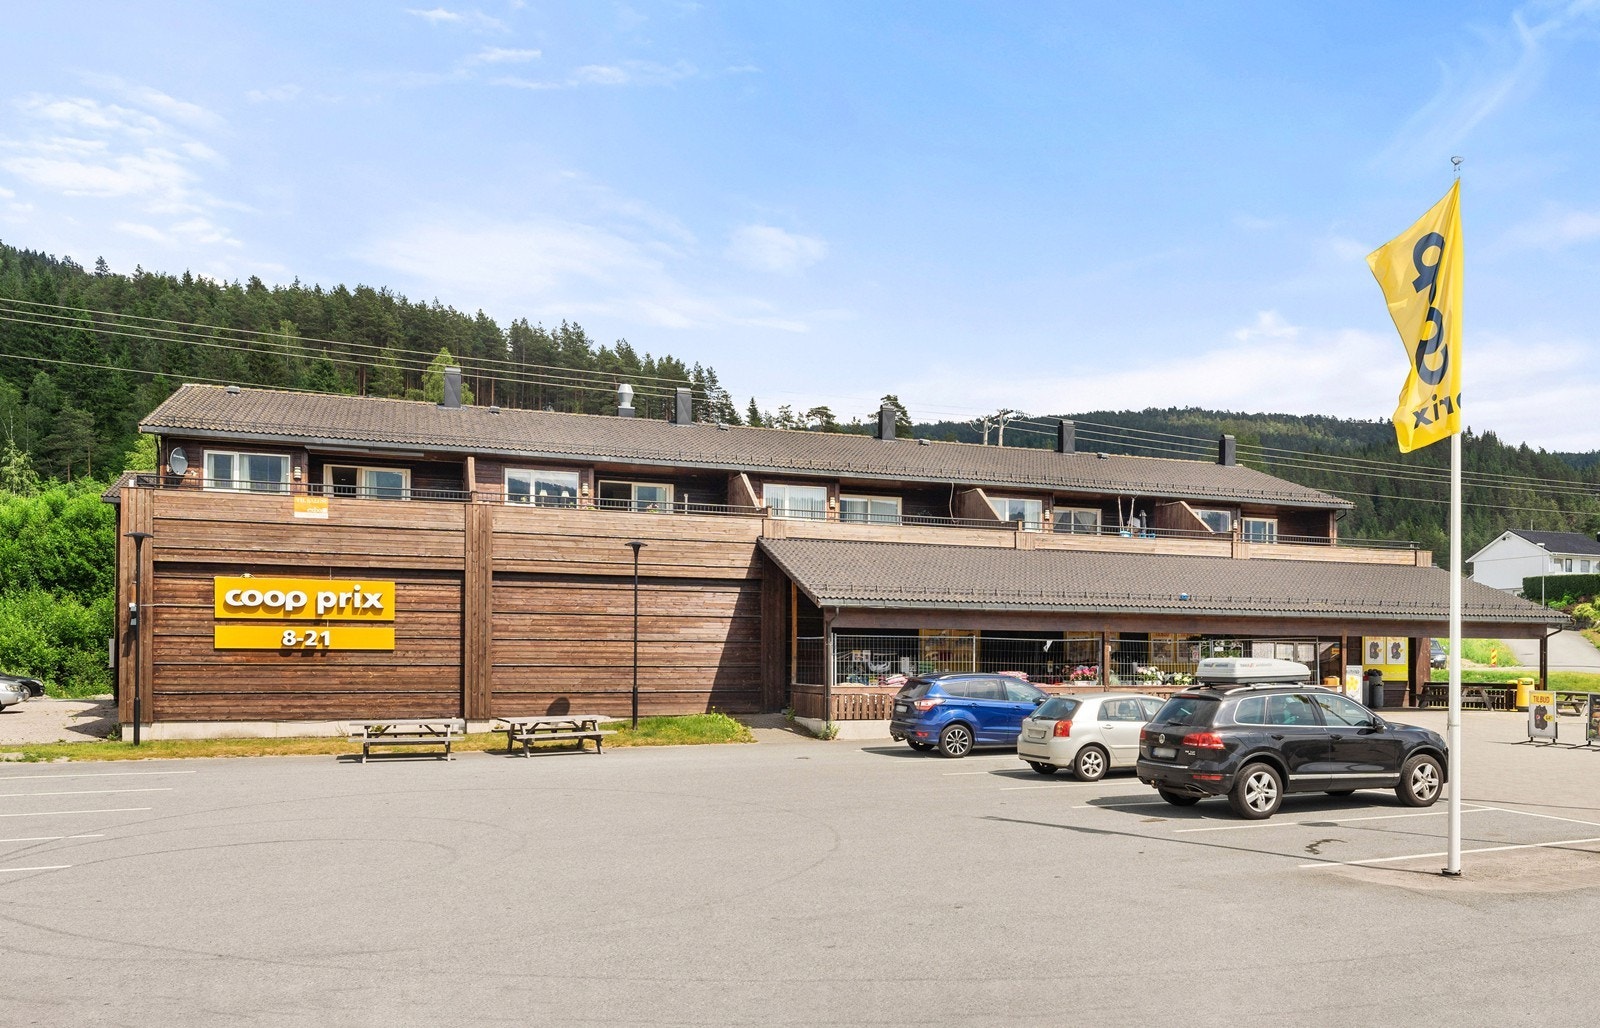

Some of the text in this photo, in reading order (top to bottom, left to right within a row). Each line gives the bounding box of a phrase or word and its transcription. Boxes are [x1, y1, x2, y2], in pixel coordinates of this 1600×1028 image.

[225, 584, 384, 615] coop prix
[282, 629, 331, 647] 8-21
[1533, 695, 1550, 704] TILBUD
